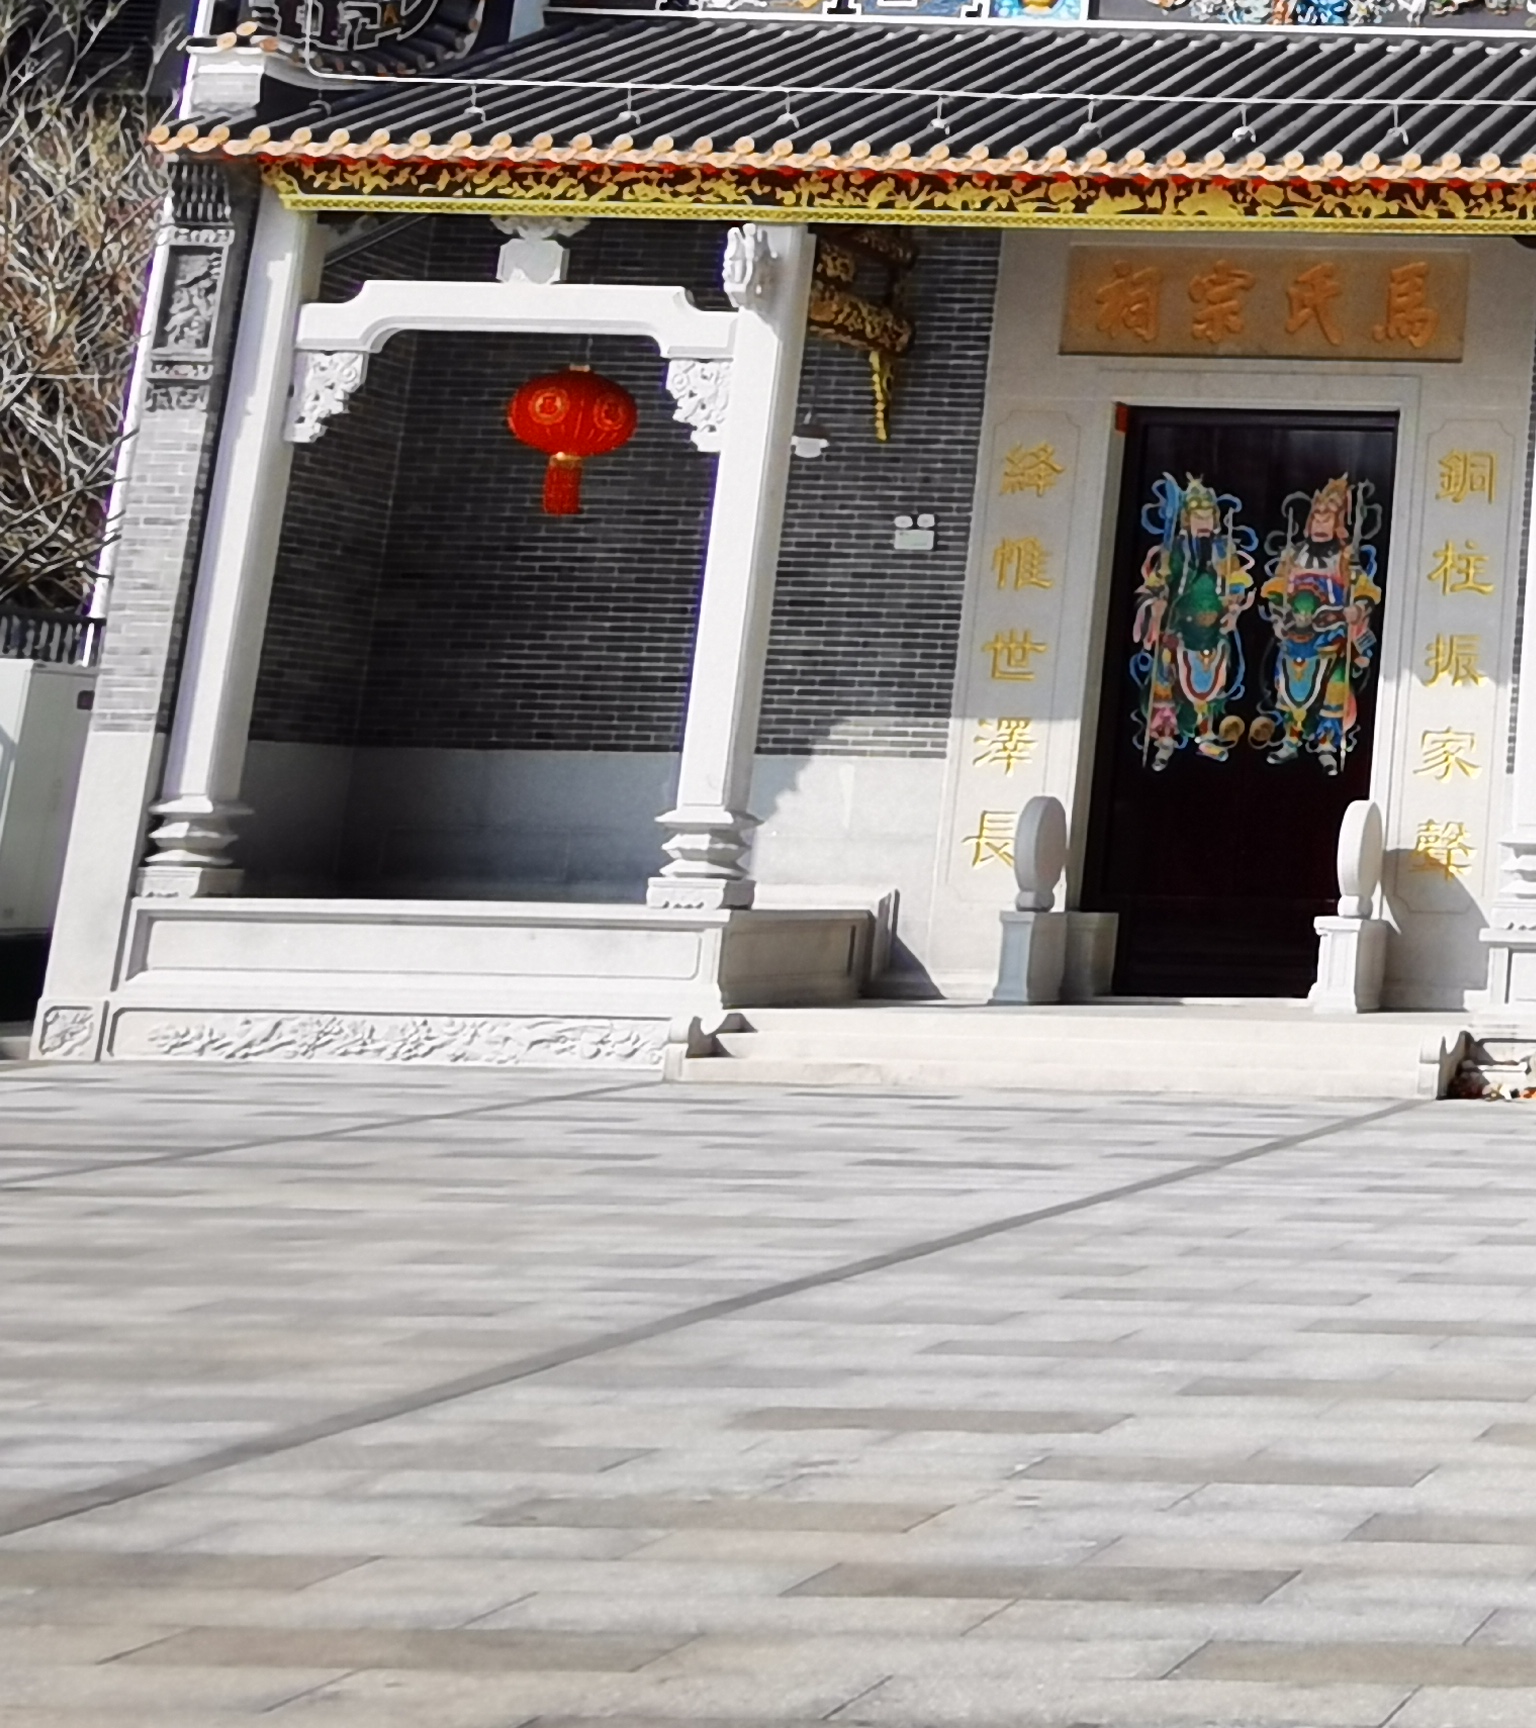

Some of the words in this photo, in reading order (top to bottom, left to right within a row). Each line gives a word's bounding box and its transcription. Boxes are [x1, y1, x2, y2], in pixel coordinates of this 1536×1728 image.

[1095, 260, 1440, 348] 馬氏宗祠
[1411, 448, 1496, 884] 銅柱振家聲
